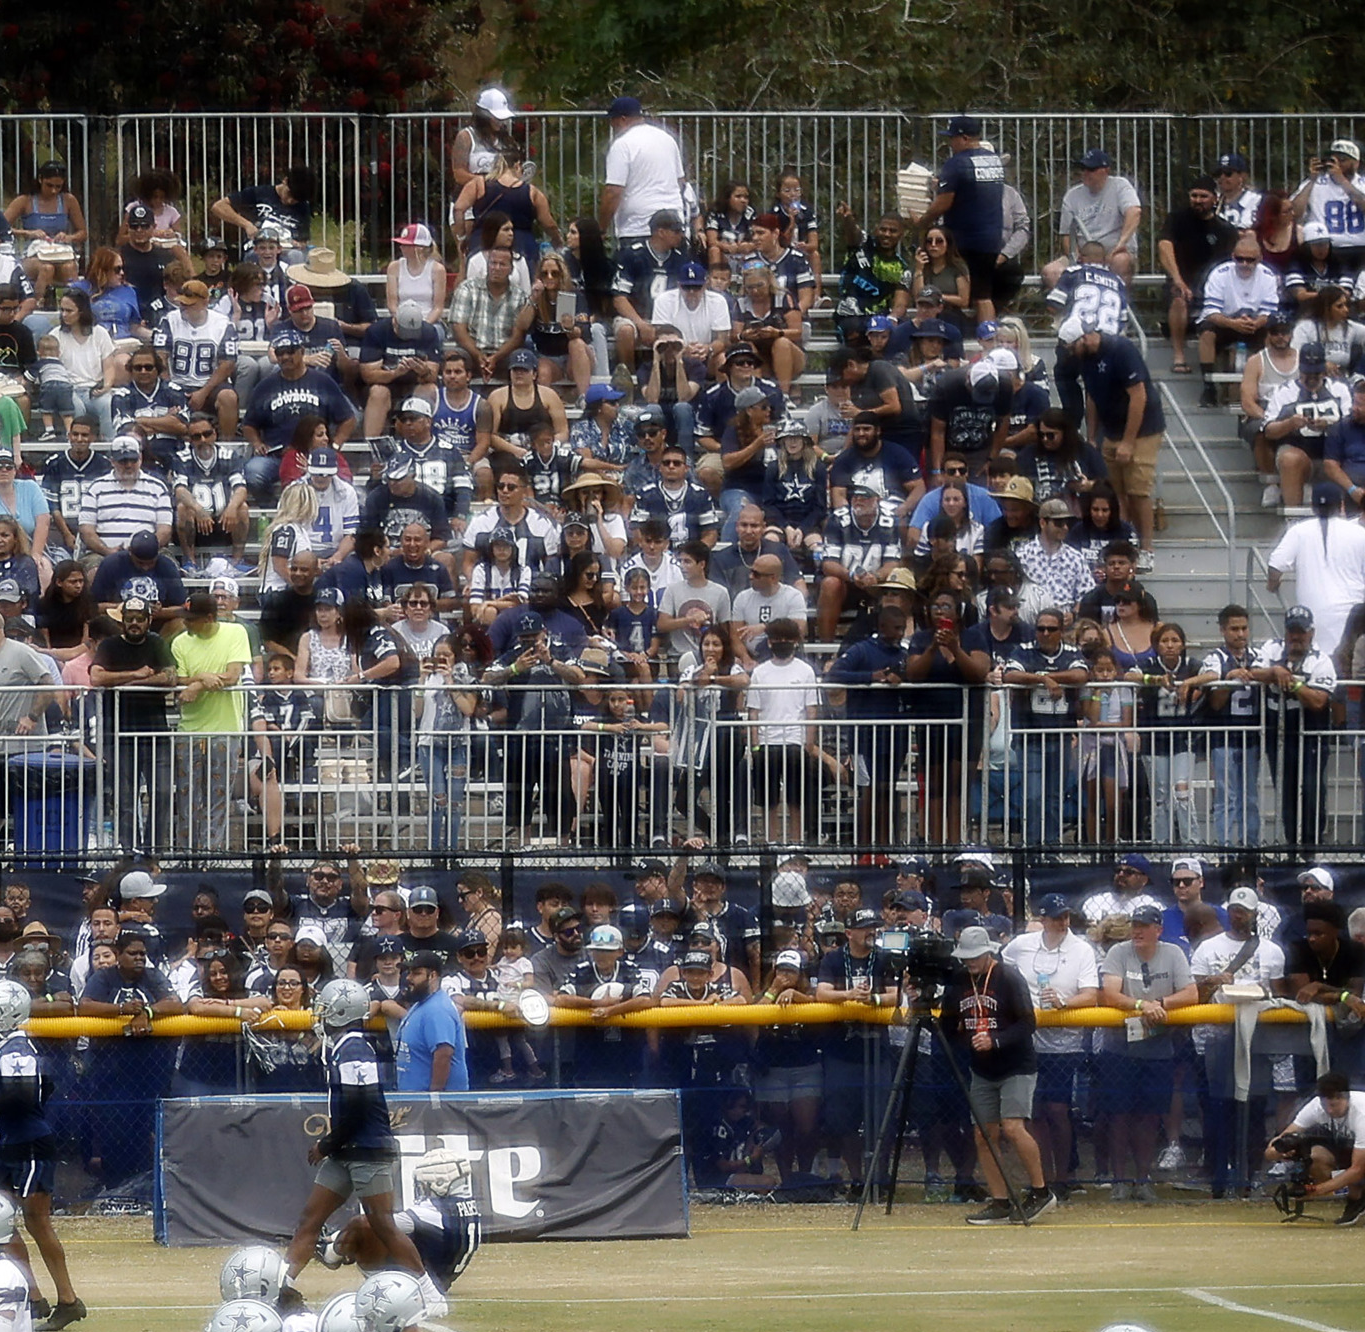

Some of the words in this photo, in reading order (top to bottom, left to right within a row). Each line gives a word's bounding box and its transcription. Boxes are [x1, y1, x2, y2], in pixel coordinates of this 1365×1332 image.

[1324, 200, 1365, 234] 88
[1073, 283, 1120, 323] 22
[174, 342, 214, 374] 88
[271, 393, 319, 409] COWBOYS
[315, 505, 332, 543] 4
[670, 516, 689, 543] 4
[276, 535, 289, 549] 21
[631, 617, 643, 653] 4
[279, 704, 296, 730] 7
[1229, 689, 1255, 715] 2
[393, 1134, 542, 1218] ite
